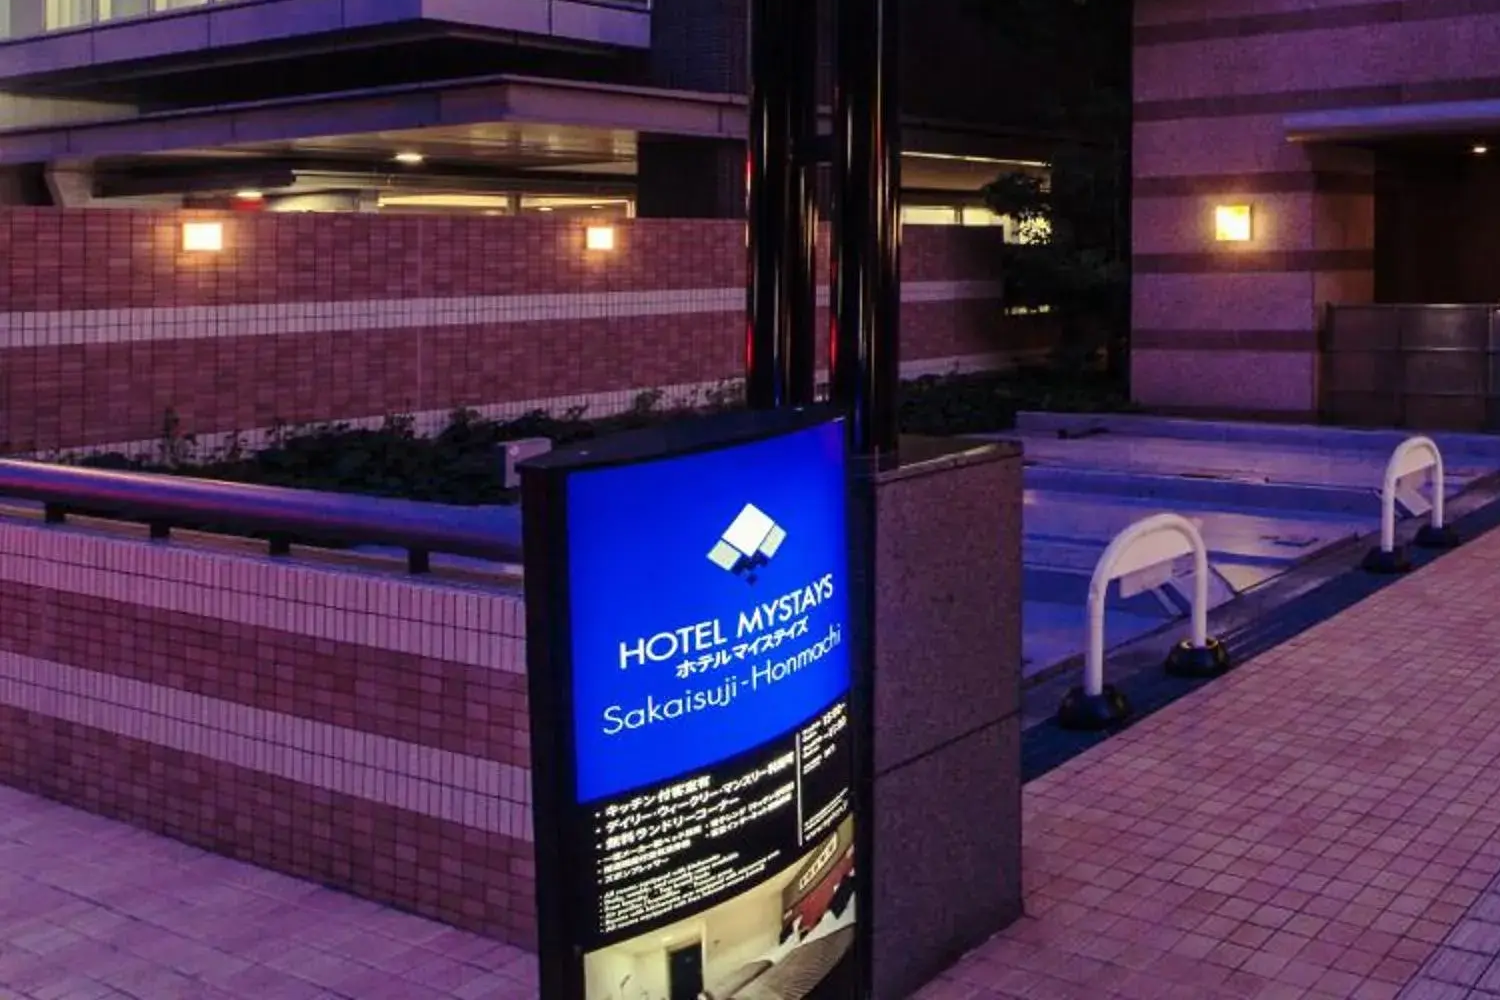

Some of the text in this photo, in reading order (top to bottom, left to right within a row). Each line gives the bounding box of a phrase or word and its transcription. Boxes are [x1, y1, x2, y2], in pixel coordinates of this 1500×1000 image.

[618, 573, 834, 671] HOTEL MYSTAYS
[675, 615, 809, 679] ホテルマイステイズ
